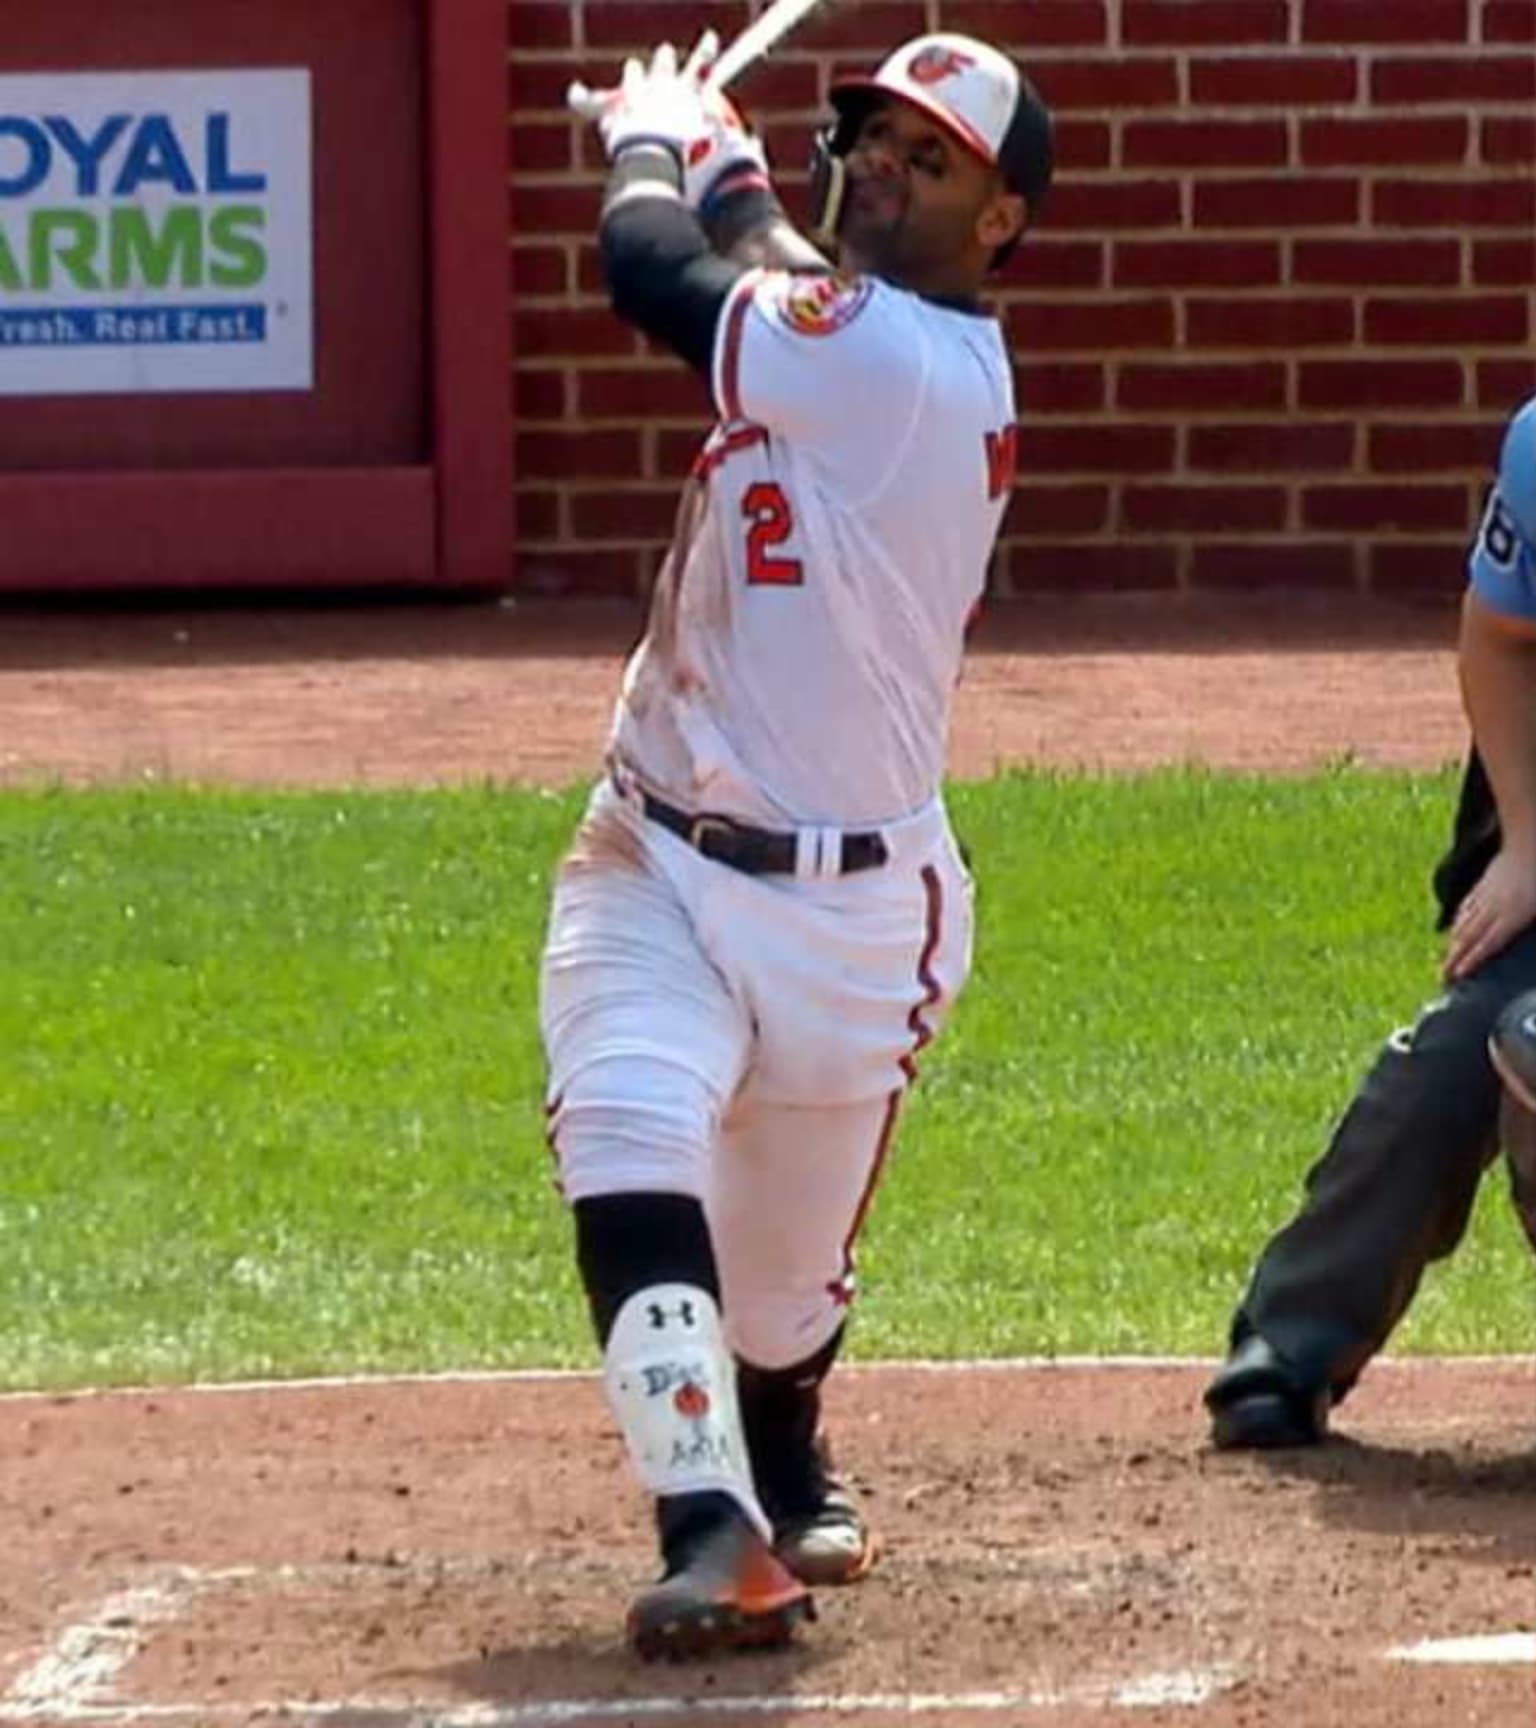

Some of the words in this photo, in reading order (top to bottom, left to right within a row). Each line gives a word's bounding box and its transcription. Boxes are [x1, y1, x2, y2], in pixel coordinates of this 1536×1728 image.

[0, 112, 267, 197] OYAL
[95, 309, 167, 338] Real
[741, 481, 805, 585] 2
